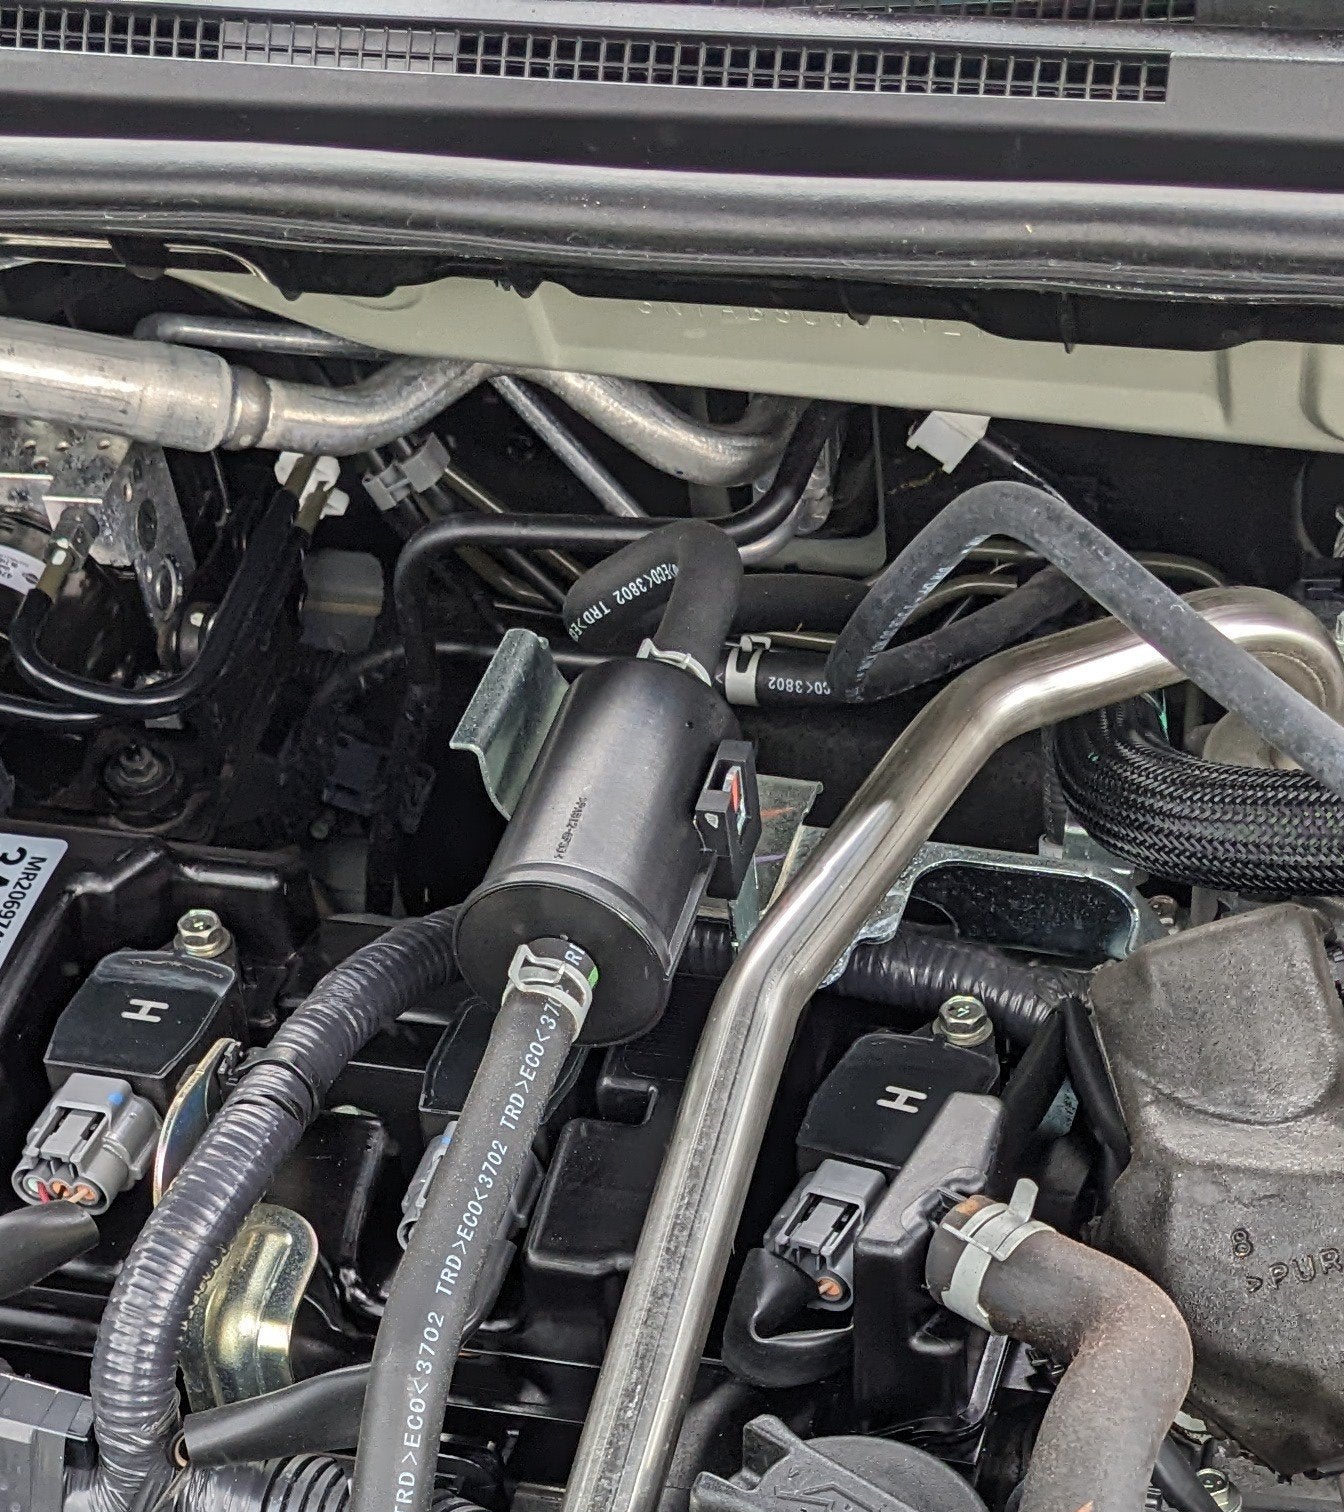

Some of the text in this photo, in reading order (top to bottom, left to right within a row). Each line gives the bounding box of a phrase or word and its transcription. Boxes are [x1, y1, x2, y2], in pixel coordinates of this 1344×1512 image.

[121, 997, 170, 1026] H
[875, 1083, 930, 1117] H
[435, 1139, 508, 1297] TRD>ECO<3702
[1230, 1227, 1254, 1259] 8
